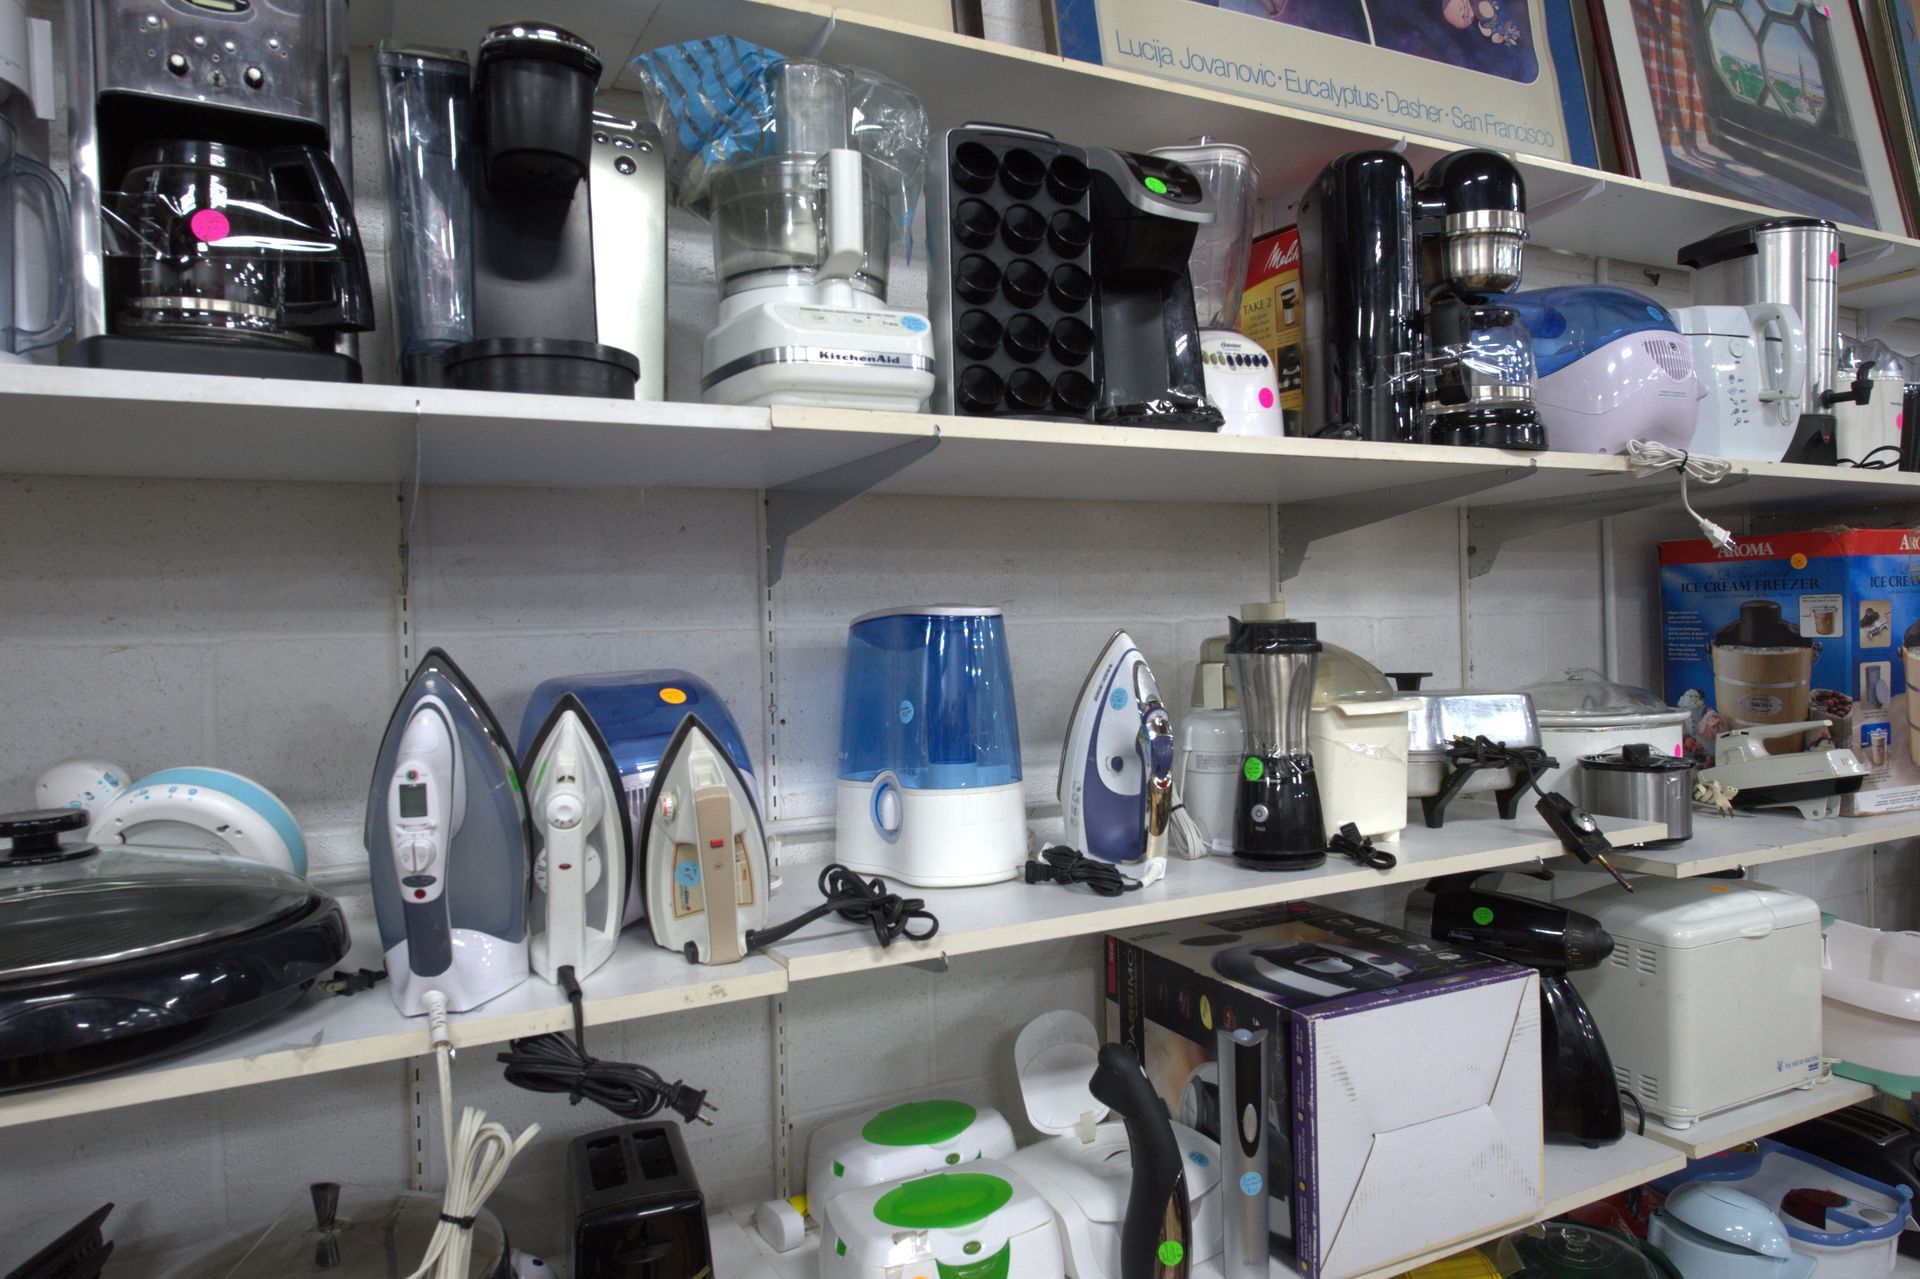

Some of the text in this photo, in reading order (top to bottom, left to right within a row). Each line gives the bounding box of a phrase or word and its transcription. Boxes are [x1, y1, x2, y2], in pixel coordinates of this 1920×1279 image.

[1115, 30, 1554, 148] Lucija Jovanovic Eucalyptus Dasher San Francisco
[1242, 299, 1265, 315] TAKE
[819, 350, 901, 365] KitchenAid
[1717, 542, 1774, 558] AROMA
[1681, 577, 1820, 593] ICE CREAM FREEZER
[1870, 575, 1920, 588] ICE CRE
